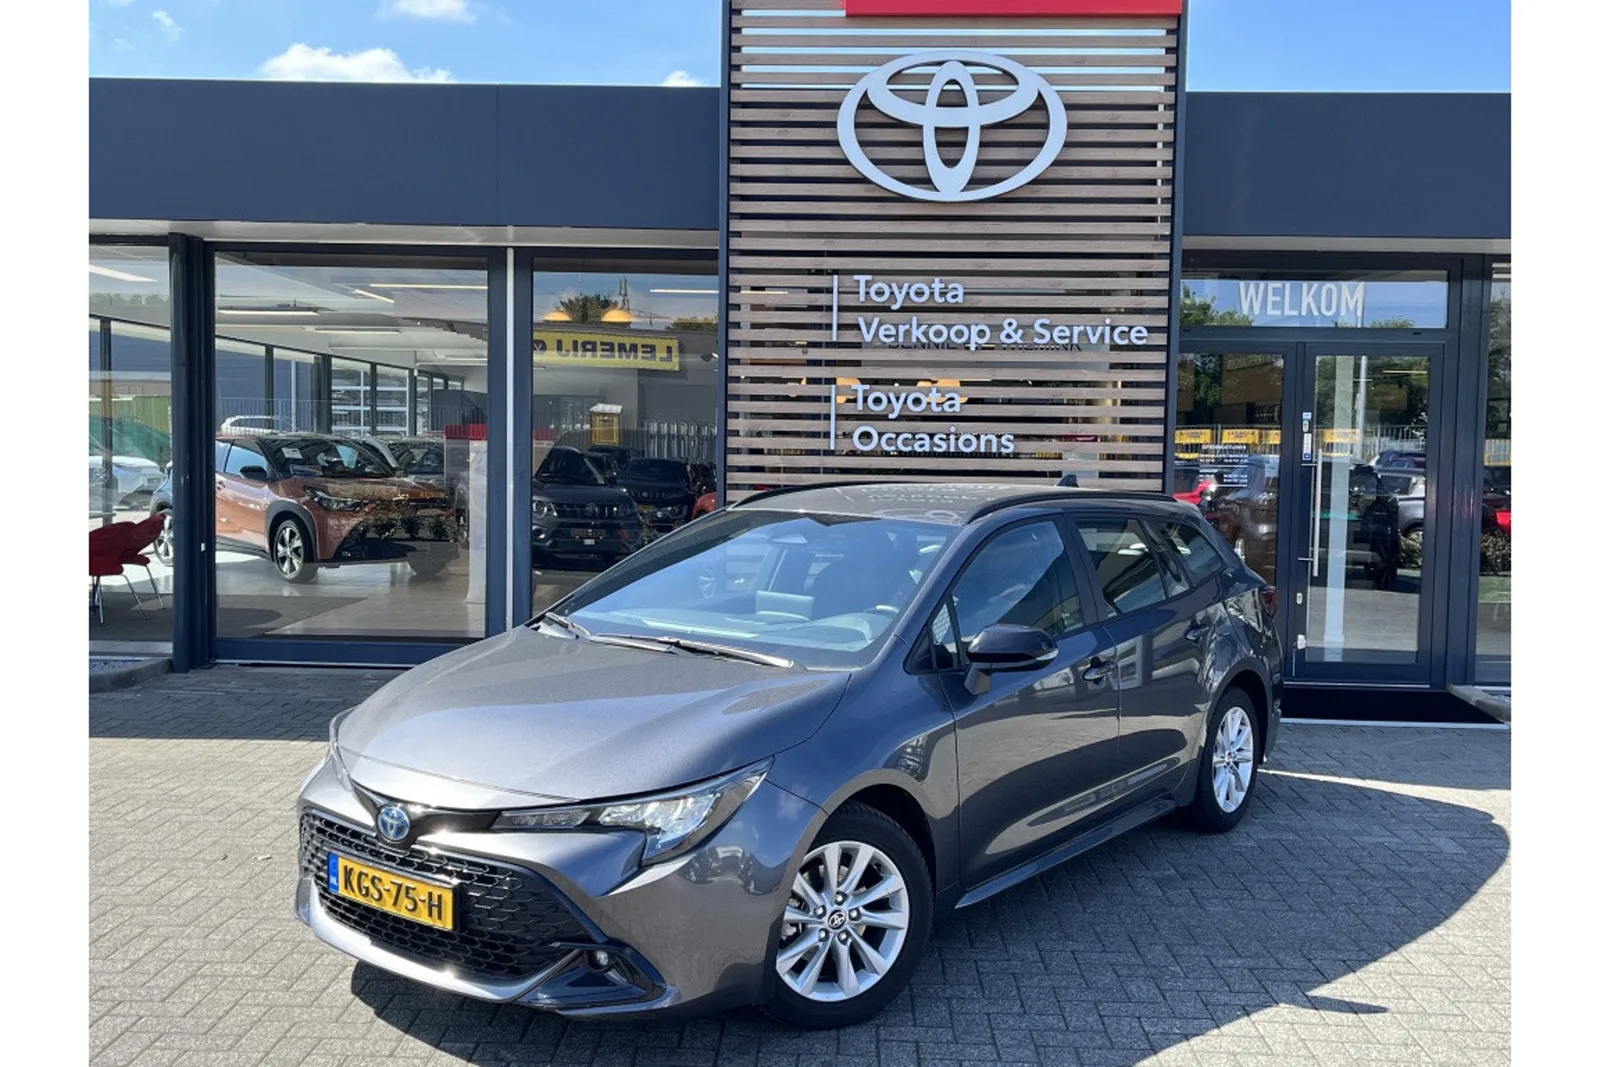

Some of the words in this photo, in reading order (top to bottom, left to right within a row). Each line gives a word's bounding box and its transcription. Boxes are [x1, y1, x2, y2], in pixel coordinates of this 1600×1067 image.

[853, 276, 964, 309] Toyota
[1240, 283, 1365, 317] WELKOM
[858, 317, 990, 350] Verkoop
[1000, 319, 1023, 344] &
[1034, 318, 1147, 345] Service
[852, 385, 961, 418] Toyota
[853, 427, 1015, 454] Occasions
[344, 865, 442, 920] KGS-75-H
